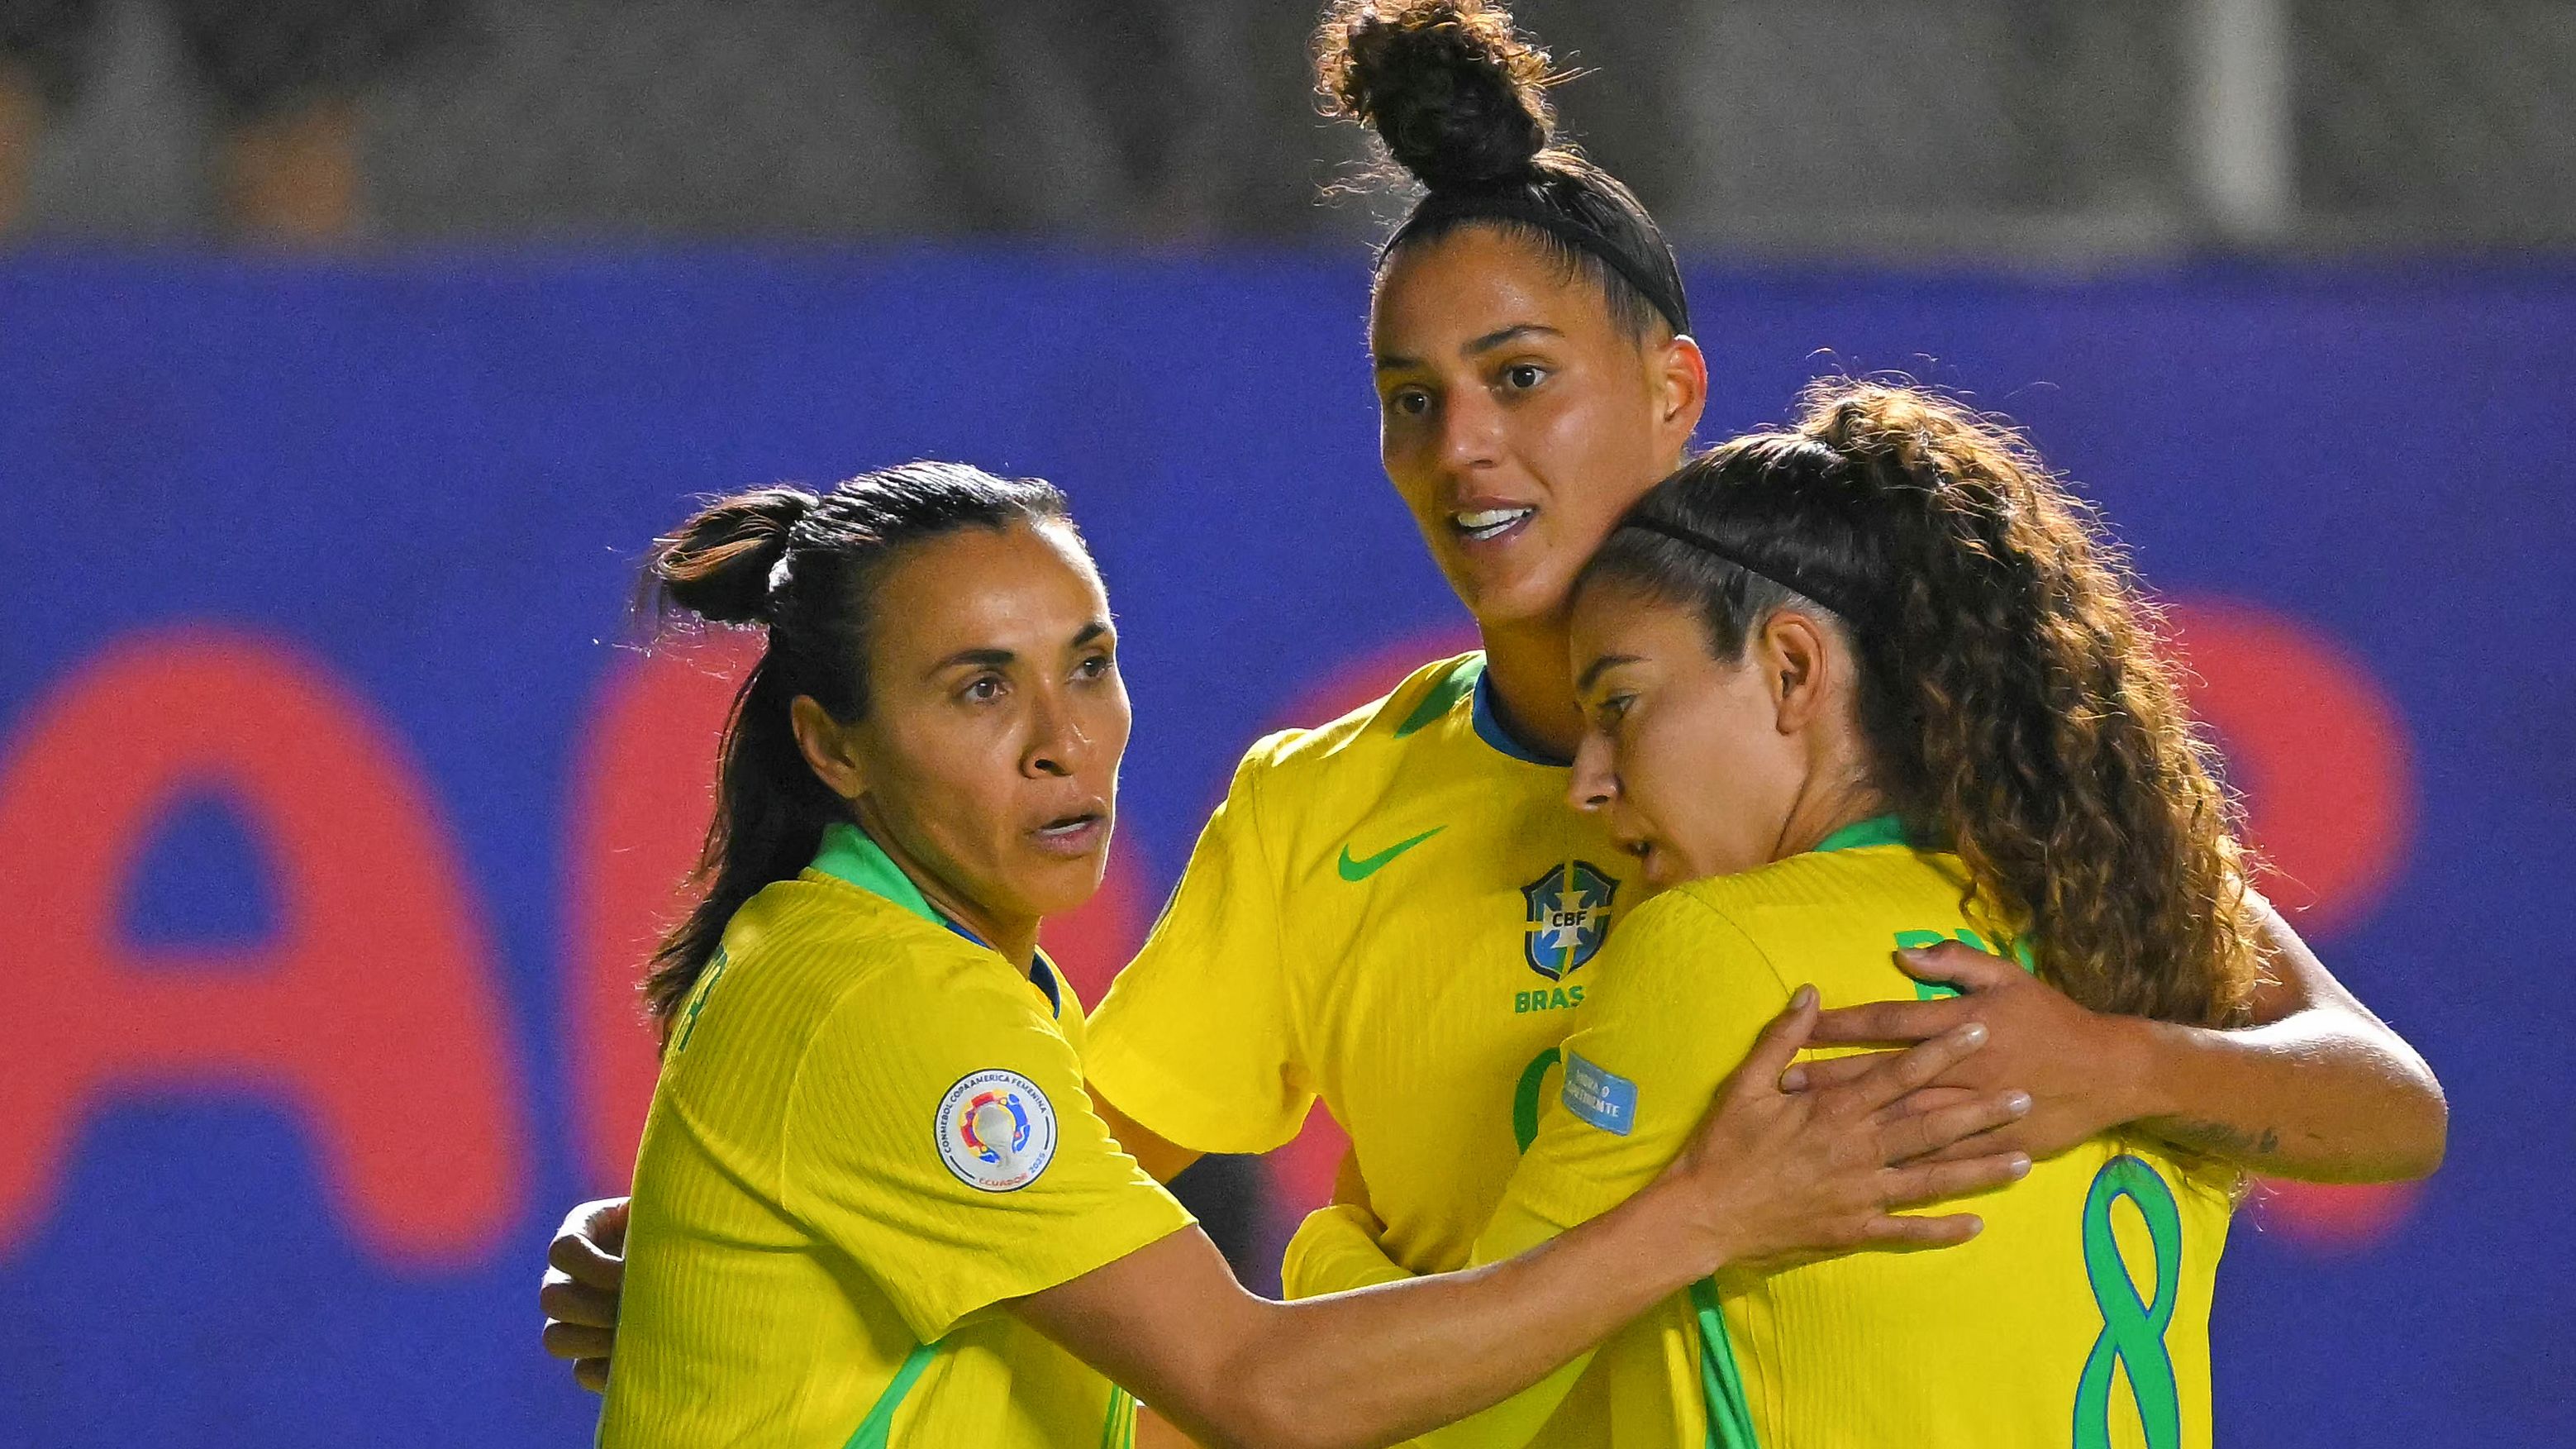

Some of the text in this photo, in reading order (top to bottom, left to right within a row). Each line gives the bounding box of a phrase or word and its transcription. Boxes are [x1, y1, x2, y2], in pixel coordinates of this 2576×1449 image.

[1551, 910, 1588, 927] CBF
[940, 1075, 1047, 1154] CONMEBOL COPA AMERICA FEMENINA
[978, 1172, 1028, 1187] ECUADOR
[2073, 1155, 2183, 1449] 8
